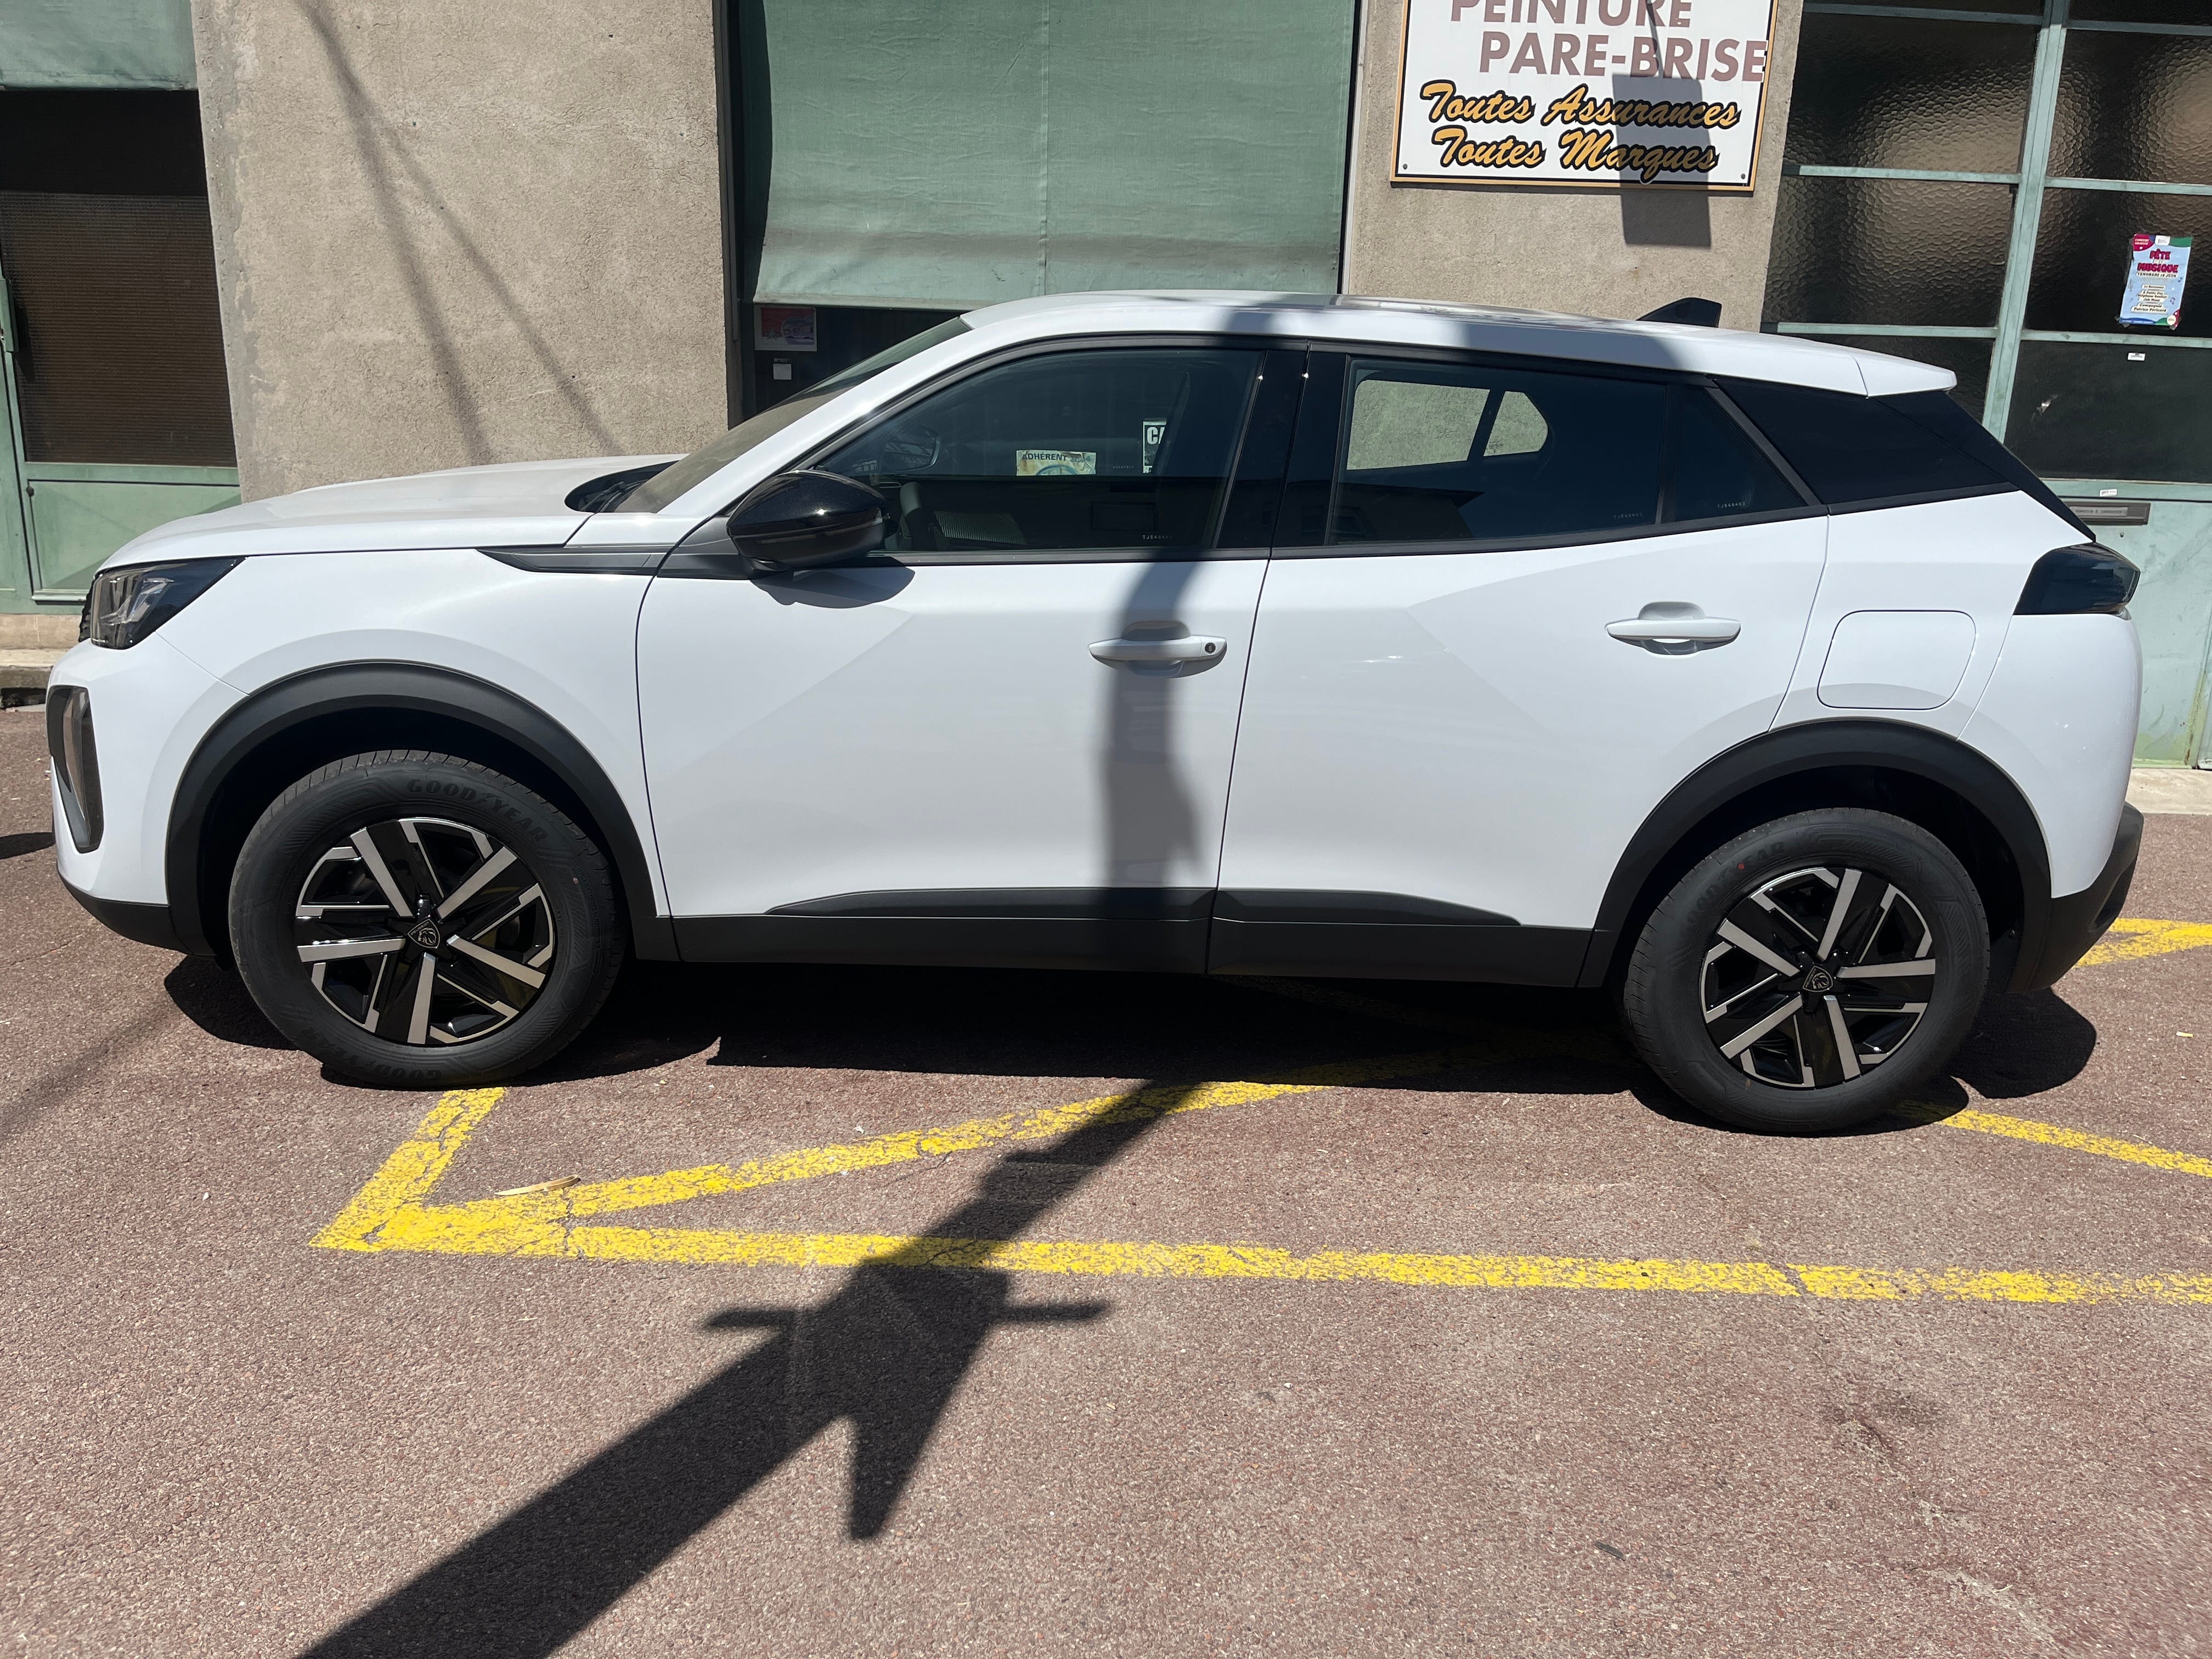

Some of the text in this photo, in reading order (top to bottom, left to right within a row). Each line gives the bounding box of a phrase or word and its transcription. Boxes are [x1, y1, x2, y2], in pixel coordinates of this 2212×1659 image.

[1480, 31, 1768, 82] PARE-BRISE
[1420, 80, 1742, 128] Toutes Assurances
[1432, 125, 1719, 184] Toutes Marques
[2137, 262, 2179, 273] MUSIQUE
[2149, 248, 2171, 260] FÊTE
[1022, 452, 1067, 461] ADHÉRENT
[407, 778, 550, 843] GOODYEAR
